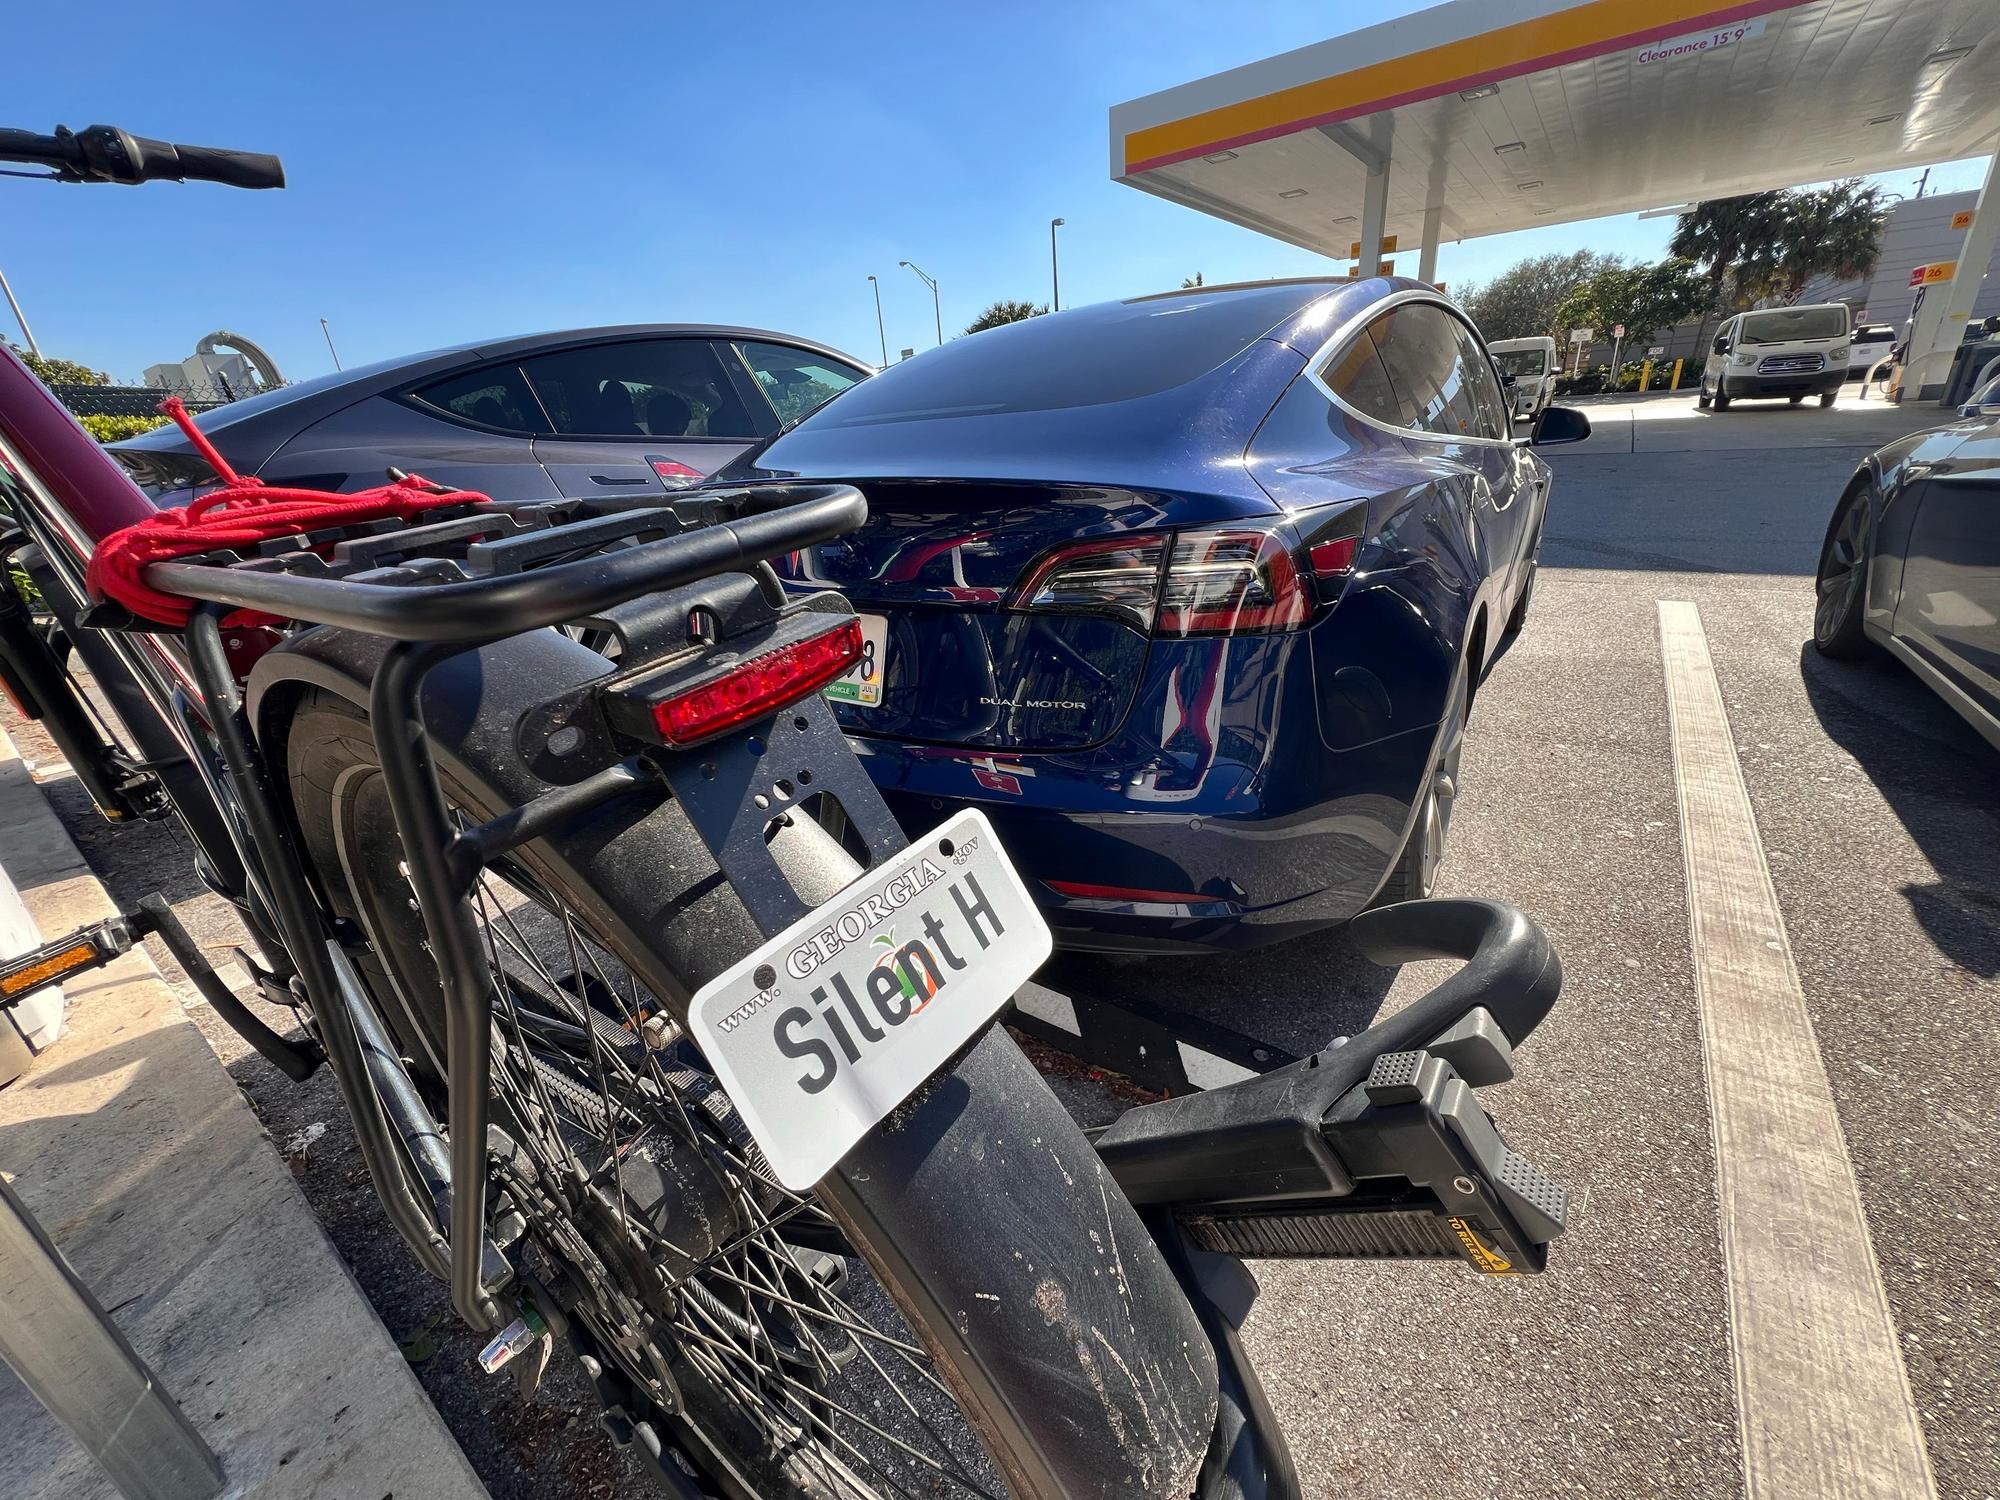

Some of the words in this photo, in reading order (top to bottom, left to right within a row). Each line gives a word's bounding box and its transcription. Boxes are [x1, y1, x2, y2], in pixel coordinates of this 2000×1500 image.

[1638, 40, 1707, 64] Clearance
[1957, 215, 1969, 224] 26
[1927, 267, 1942, 278] 26
[829, 685, 850, 695] VEHICLE
[862, 686, 873, 694] JUL
[980, 697, 1022, 707] DUAL
[1026, 700, 1087, 710] MOTOR
[717, 987, 781, 1034] www.
[785, 858, 945, 980] GEORGIA
[952, 837, 979, 866] .gov
[773, 911, 969, 1096] Silent
[947, 870, 1005, 952] H
[1448, 1217, 1462, 1230] TO
[1456, 1229, 1493, 1271] RELEASE
